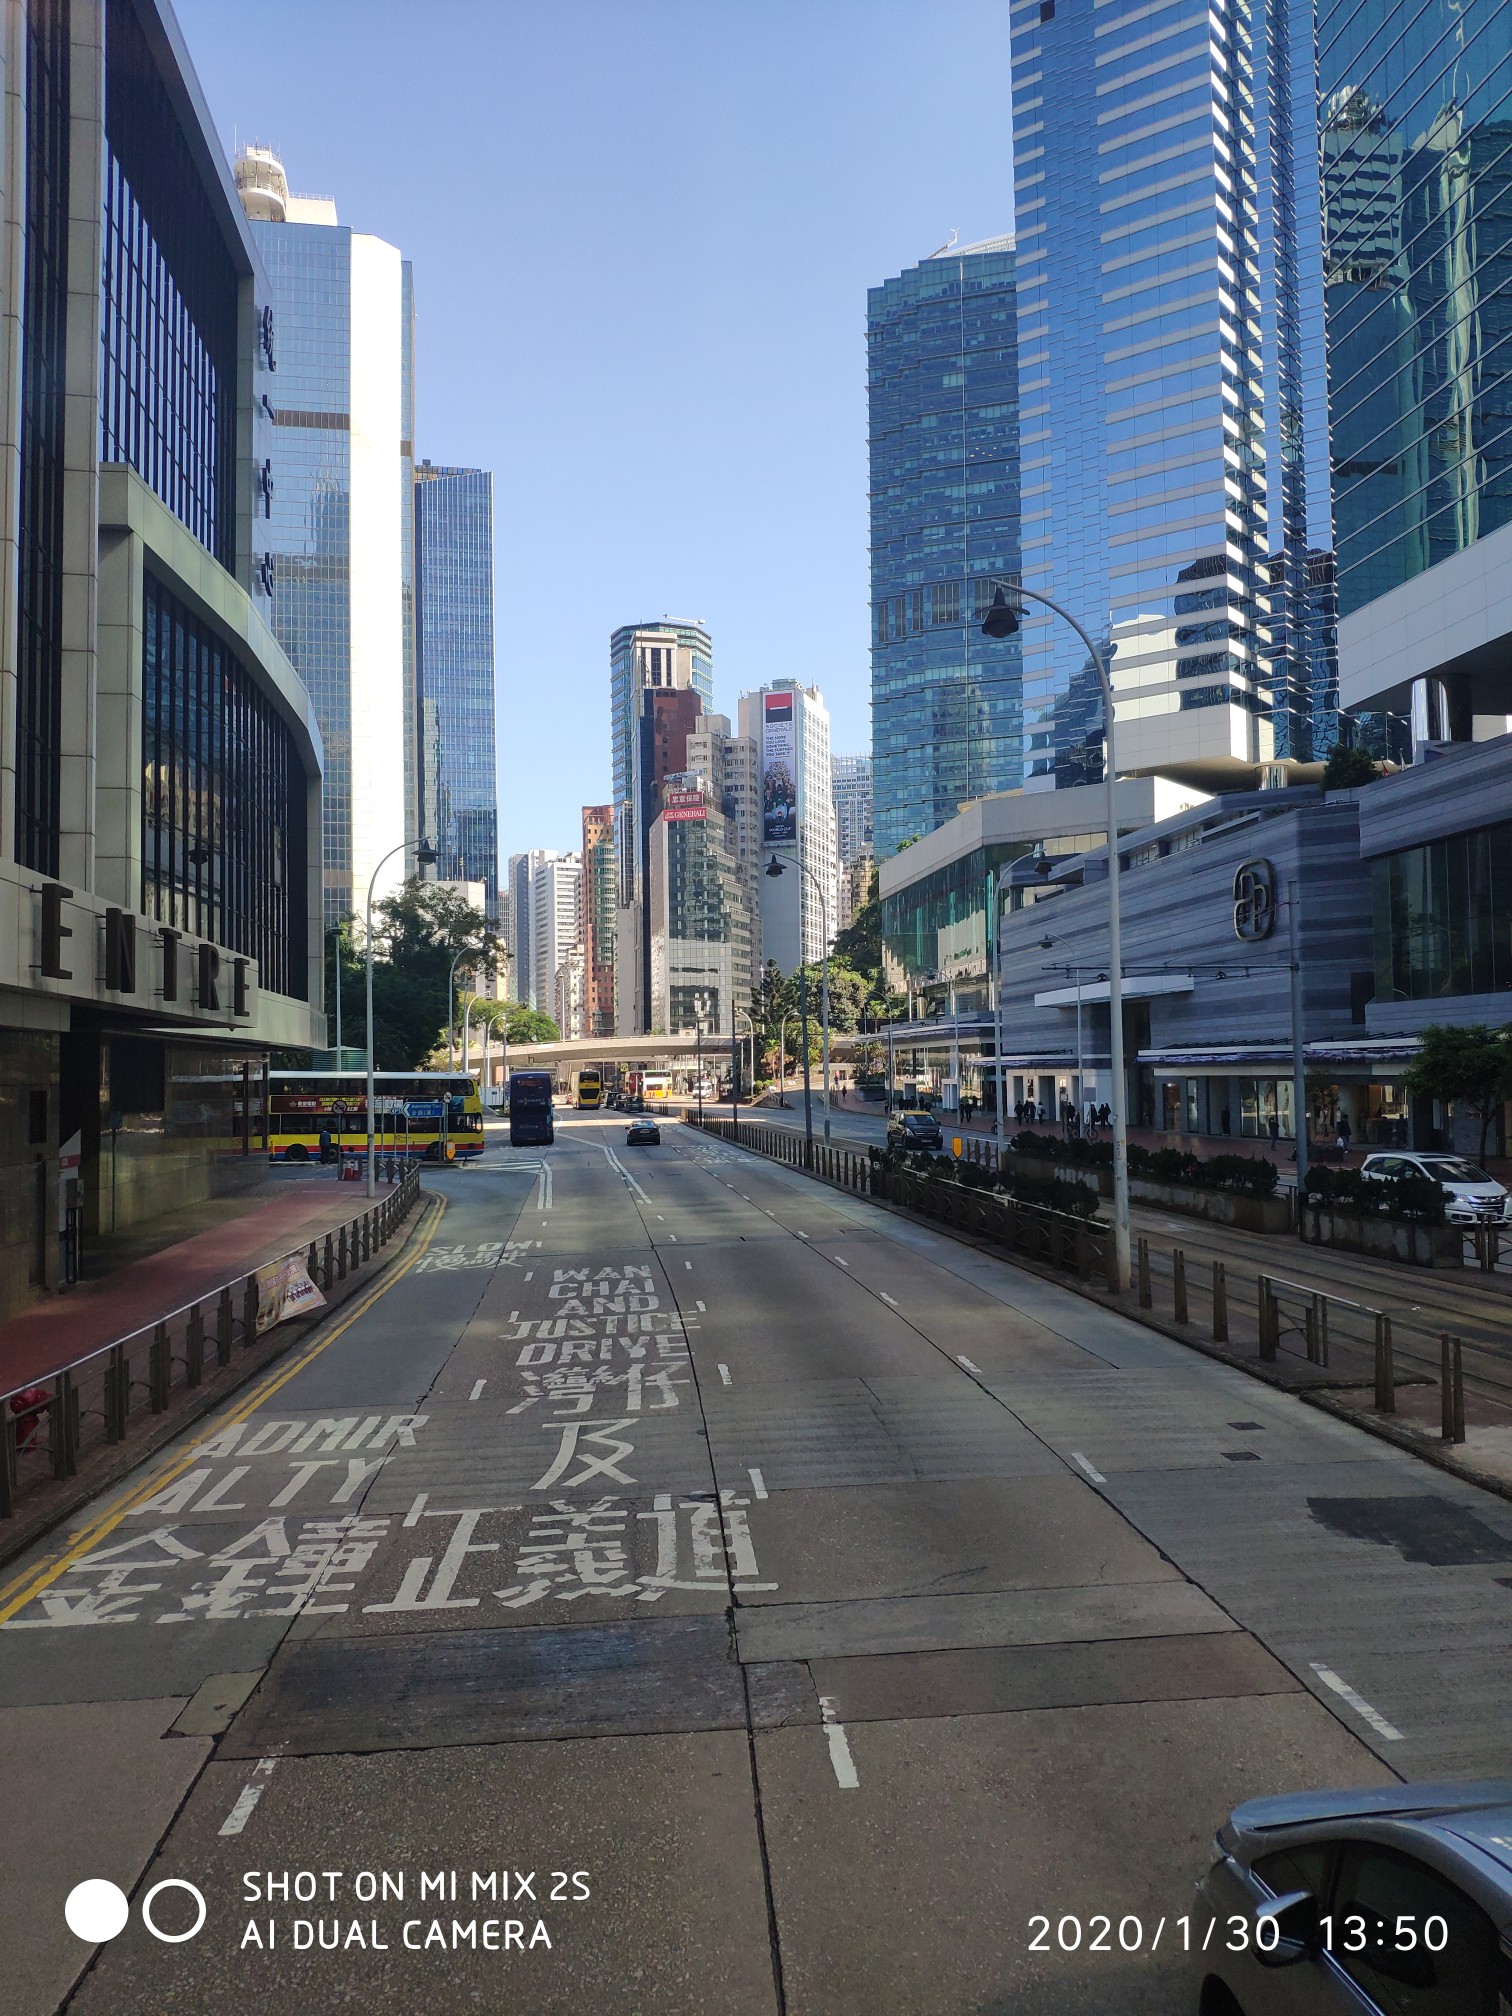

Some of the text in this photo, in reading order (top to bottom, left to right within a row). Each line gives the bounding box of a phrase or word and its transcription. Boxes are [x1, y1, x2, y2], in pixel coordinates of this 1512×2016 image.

[675, 809, 706, 819] GENERALI
[415, 1250, 527, 1273] 慢駛
[426, 1241, 532, 1257] SLOW
[548, 1278, 655, 1298] CHAI
[553, 1265, 652, 1282] WAN
[554, 1295, 660, 1316] AND
[499, 1311, 701, 1340] JUSTICE
[516, 1334, 695, 1366] DRIVE
[505, 1361, 691, 1415] 灣仔
[187, 1414, 430, 1459] ADMIR
[529, 1418, 639, 1490] 及
[126, 1456, 396, 1516] ALTY
[362, 1489, 779, 1613] 正義道
[0, 1516, 391, 1629] 金鐘
